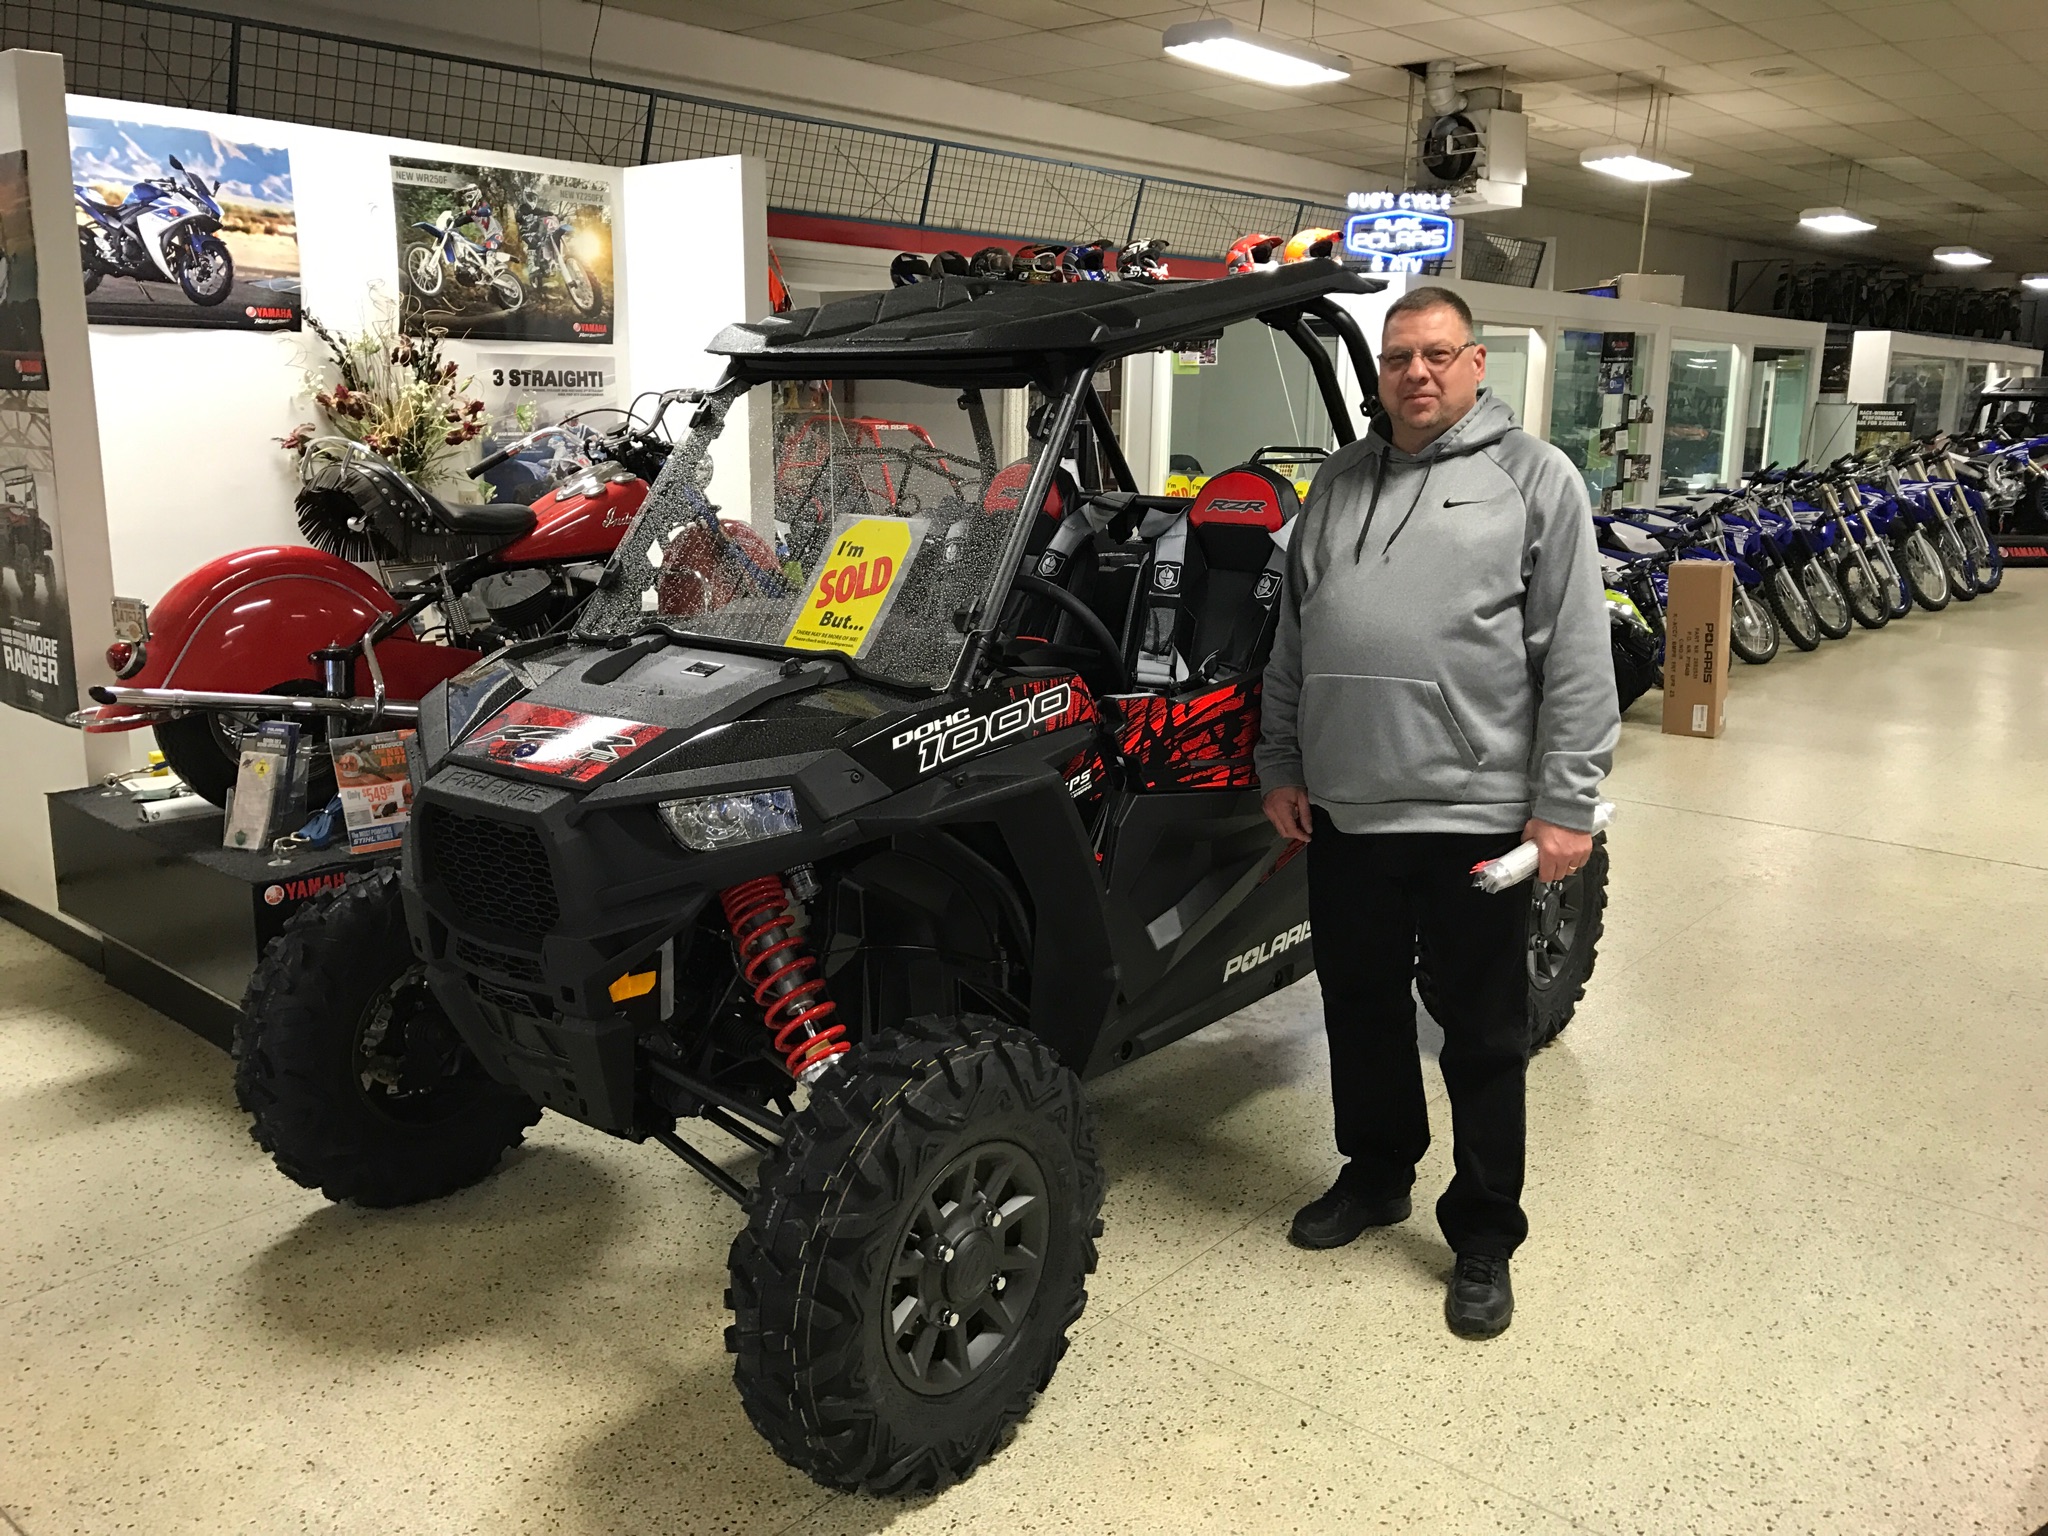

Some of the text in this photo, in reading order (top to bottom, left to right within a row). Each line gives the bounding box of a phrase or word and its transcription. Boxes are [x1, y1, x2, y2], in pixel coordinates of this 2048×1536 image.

[395, 170, 448, 185] NEW WR250F
[559, 190, 575, 199] NEW
[1399, 192, 1452, 210] CYCLE
[1353, 229, 1445, 249] POLARIS
[1389, 255, 1423, 274] ATV
[256, 307, 293, 319] YAMAHA
[493, 369, 604, 392] 3 STRAIGHT!
[1205, 498, 1268, 514] RZR
[837, 540, 865, 558] I'm
[2006, 546, 2048, 557] YAMAHA
[815, 555, 893, 609] SOLD
[819, 611, 864, 632] But...
[26, 633, 58, 658] MORE
[1703, 623, 1714, 684] POLARIS
[3, 644, 60, 686] RANGER
[892, 707, 971, 750] DOHC
[918, 683, 1071, 774] 1000
[1065, 769, 1092, 792] PS
[347, 790, 361, 801] Only
[353, 836, 377, 845] STIHL
[285, 872, 347, 901] YAMAH
